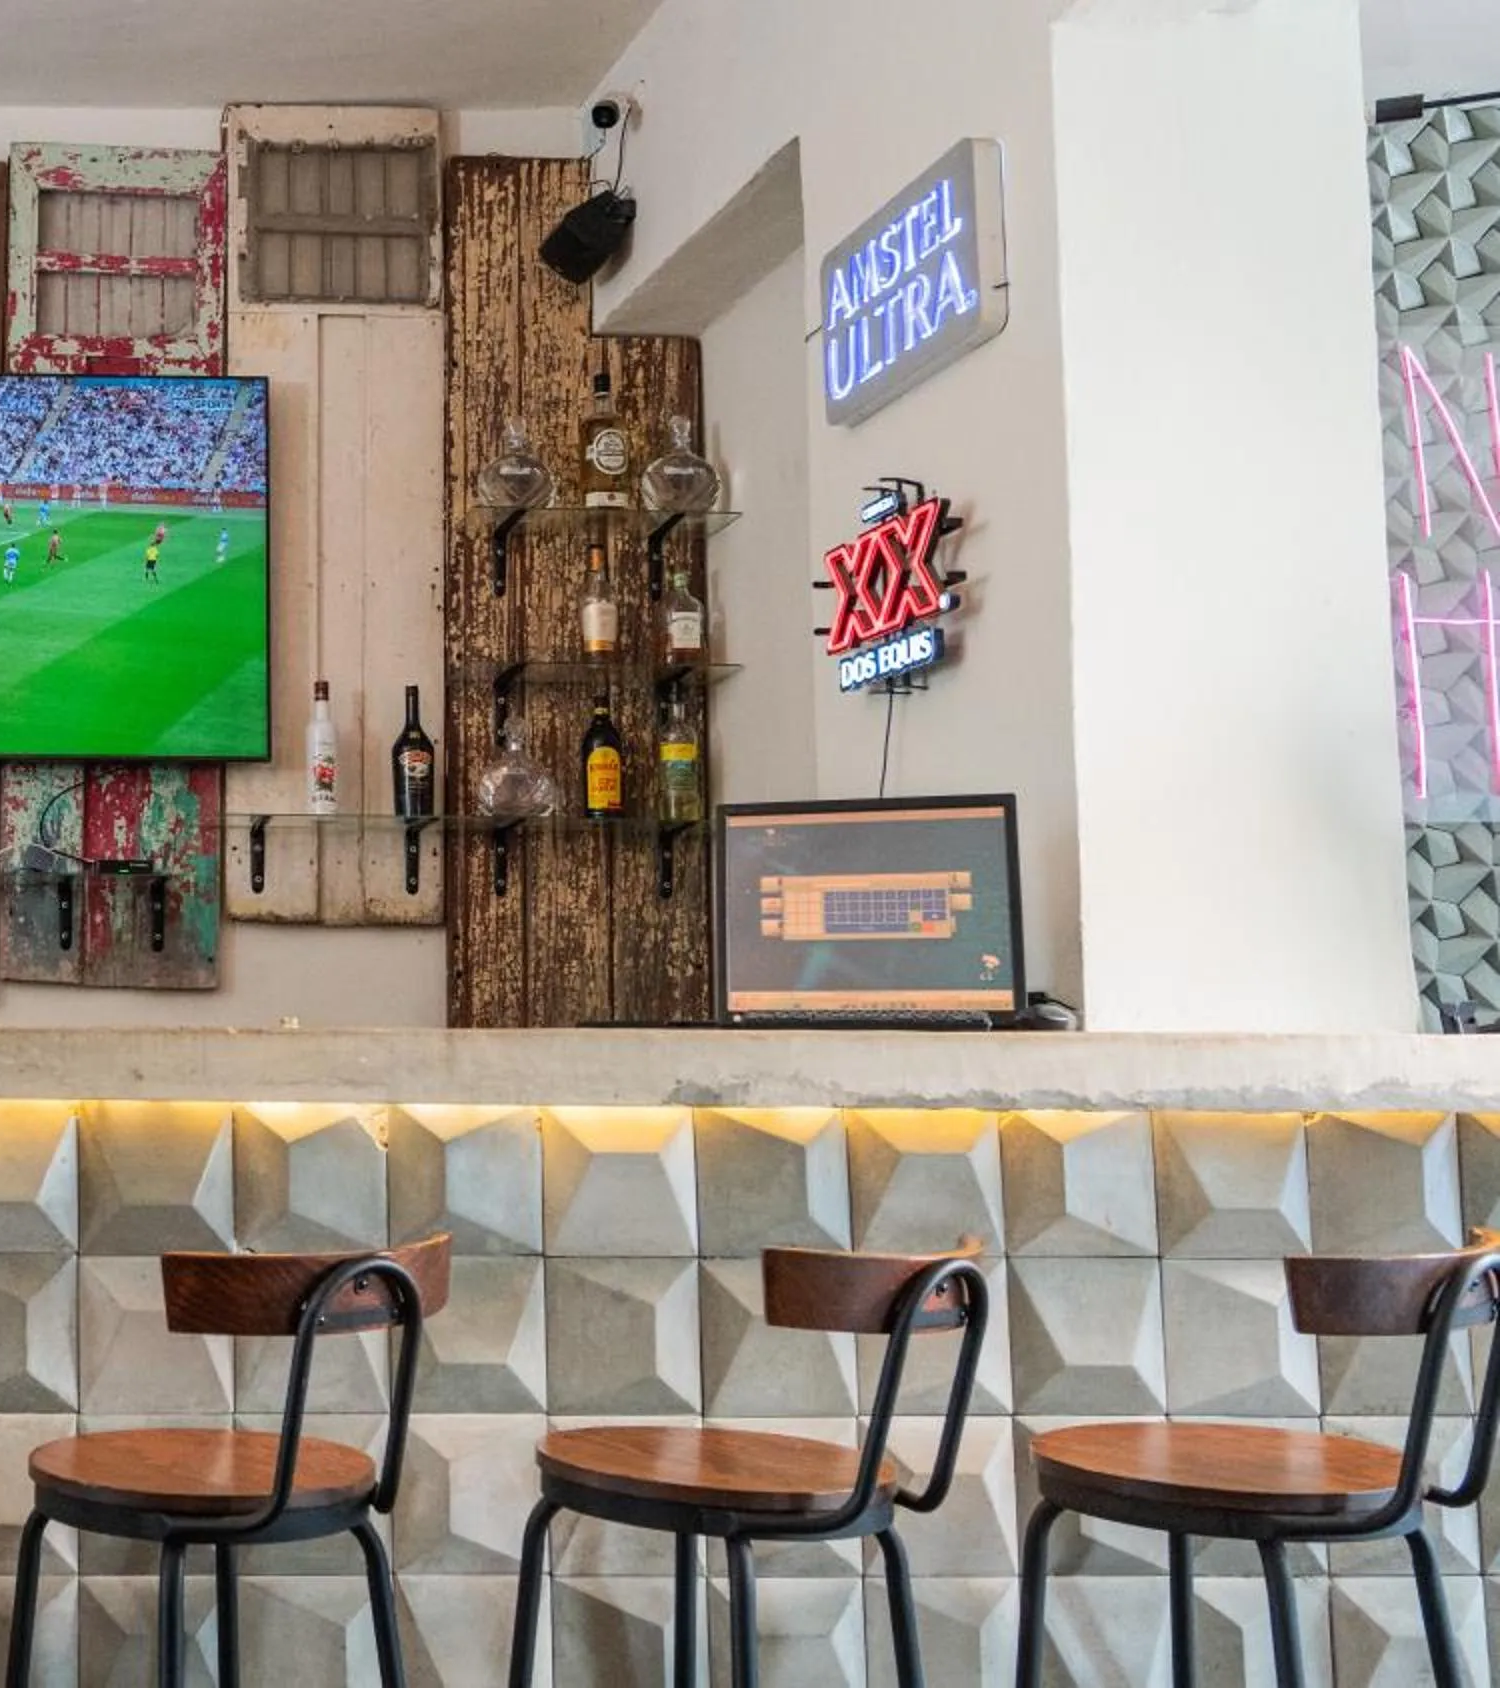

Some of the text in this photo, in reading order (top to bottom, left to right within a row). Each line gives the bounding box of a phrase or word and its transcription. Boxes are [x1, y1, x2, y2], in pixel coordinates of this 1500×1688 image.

[826, 251, 969, 400] ULTRA
[827, 179, 963, 332] AMSTEL
[824, 497, 941, 656] XX
[840, 630, 934, 689] DOS EQUIS
